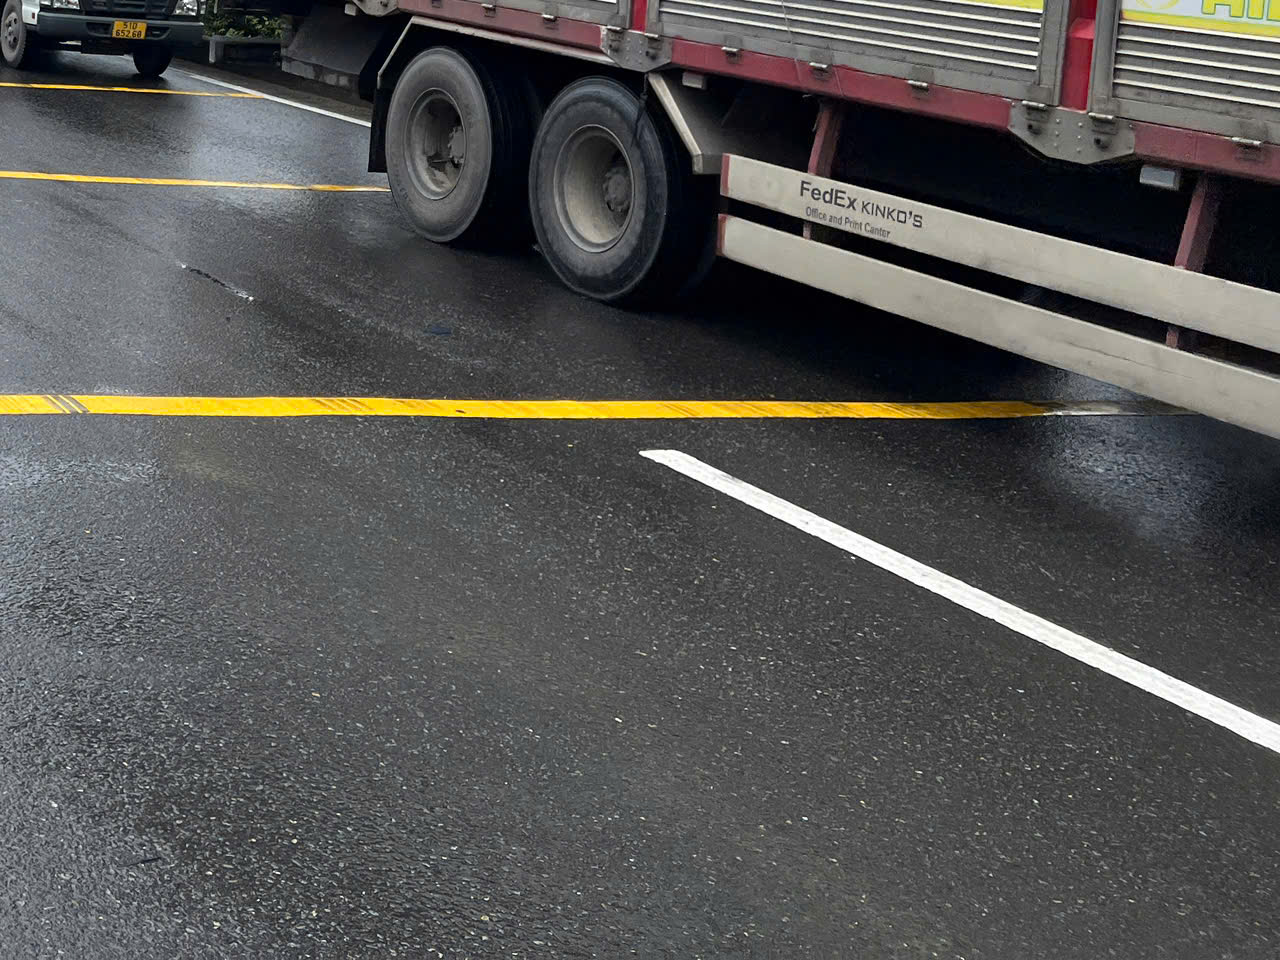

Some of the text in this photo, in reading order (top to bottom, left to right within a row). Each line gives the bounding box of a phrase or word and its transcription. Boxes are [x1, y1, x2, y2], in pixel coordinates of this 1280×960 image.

[123, 22, 138, 30] 51D
[799, 180, 858, 211] FedEx
[805, 206, 828, 220] Office
[828, 216, 843, 226] and
[844, 217, 864, 232] Print
